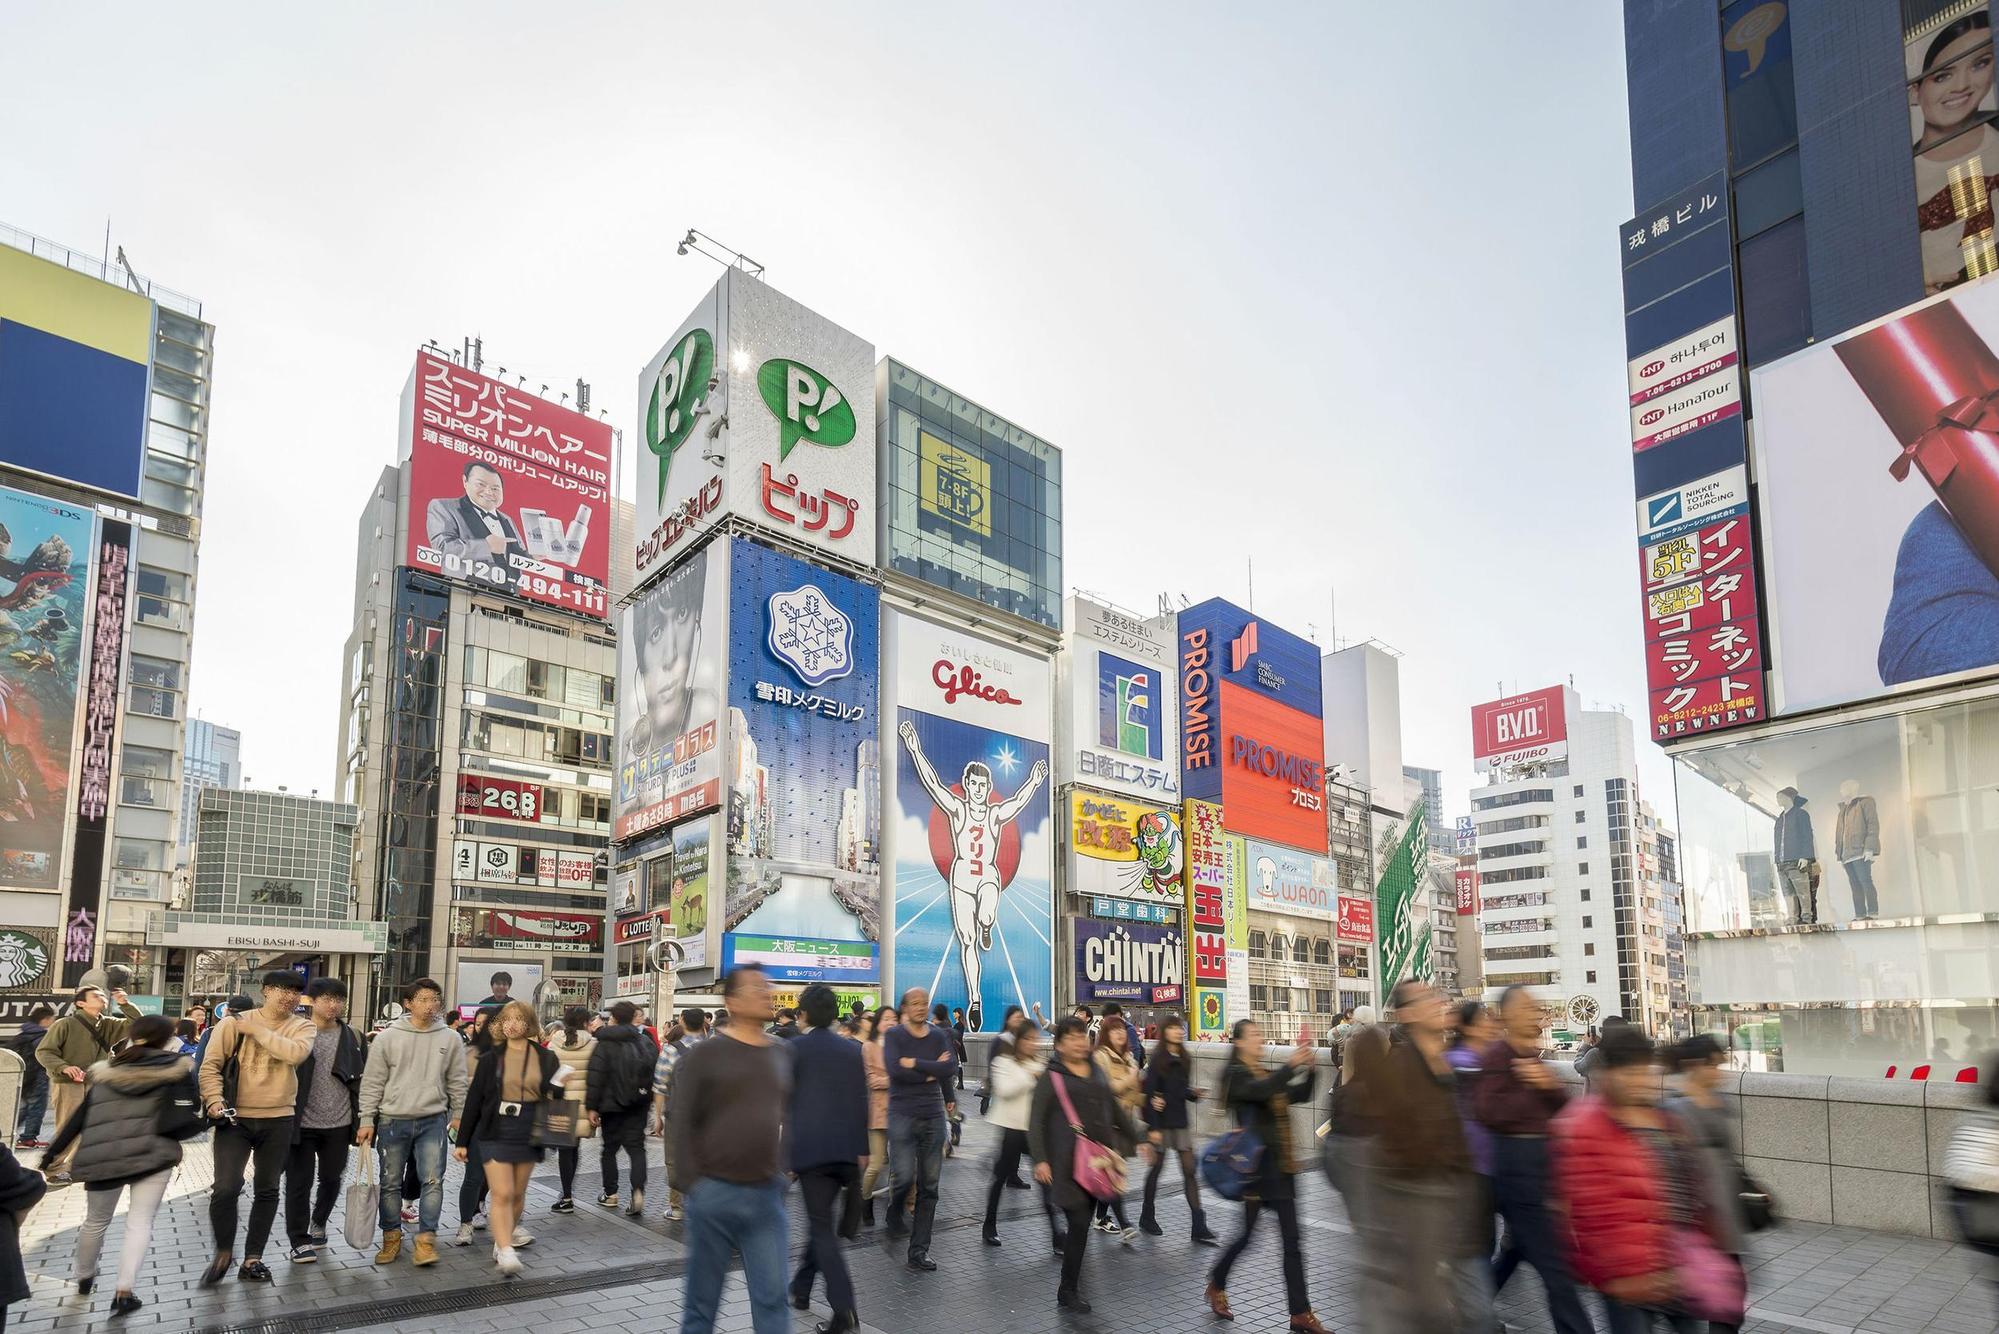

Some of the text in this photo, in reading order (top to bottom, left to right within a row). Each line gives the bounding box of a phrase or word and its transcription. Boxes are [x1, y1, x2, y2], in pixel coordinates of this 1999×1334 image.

[1628, 194, 1717, 250] 戎橋ビル
[1669, 331, 1725, 363] 하나투어
[426, 358, 532, 411] スーパー
[1668, 382, 1731, 415] HanaTour
[424, 383, 607, 462] ミリオンヘアー
[423, 408, 606, 484] SUPER MILLION HAIR
[761, 462, 859, 540] ピップ
[1686, 481, 1720, 498] NIKKEN
[1687, 492, 1715, 504] TOTAL
[1687, 491, 1735, 512] SOURCING
[49, 507, 81, 521] 3DS
[512, 555, 547, 572] ルアン
[1653, 548, 1696, 578] 5F
[444, 553, 607, 612] 0120-494-111
[1102, 610, 1154, 638] 夢ある住まい
[1702, 520, 1753, 703] インターネット
[1093, 624, 1161, 659] エステムシリーズ
[1257, 659, 1272, 673] SMBC
[1257, 665, 1287, 687] CONSUMER
[1657, 611, 1701, 713] コミック
[932, 660, 1022, 705] Glico
[1257, 676, 1282, 691] FINANCE
[754, 681, 865, 721] 雪印メグミルク
[1183, 628, 1210, 771] PROMISE
[1657, 702, 1725, 723] 06-6212-2423
[1496, 707, 1543, 743] B.V.D.
[1233, 735, 1321, 792] PROMISE
[1503, 747, 1549, 764] FUJIBO
[637, 771, 671, 793] STURDY
[672, 762, 689, 780] PLUS
[1080, 750, 1178, 793] 日商エステム
[483, 787, 536, 811] 268
[1291, 787, 1322, 811] プロミス
[968, 824, 984, 876] グリコ
[1192, 832, 1223, 849] 日本一
[571, 869, 592, 882] 0円
[1193, 866, 1225, 882] スーパー
[1282, 881, 1327, 907] WAON
[1463, 877, 1472, 908] カラオケ
[228, 936, 320, 949] EBISU BASHI-SUJI
[772, 940, 840, 954] 大阪ニュース
[1085, 926, 1182, 985] CHINTAI
